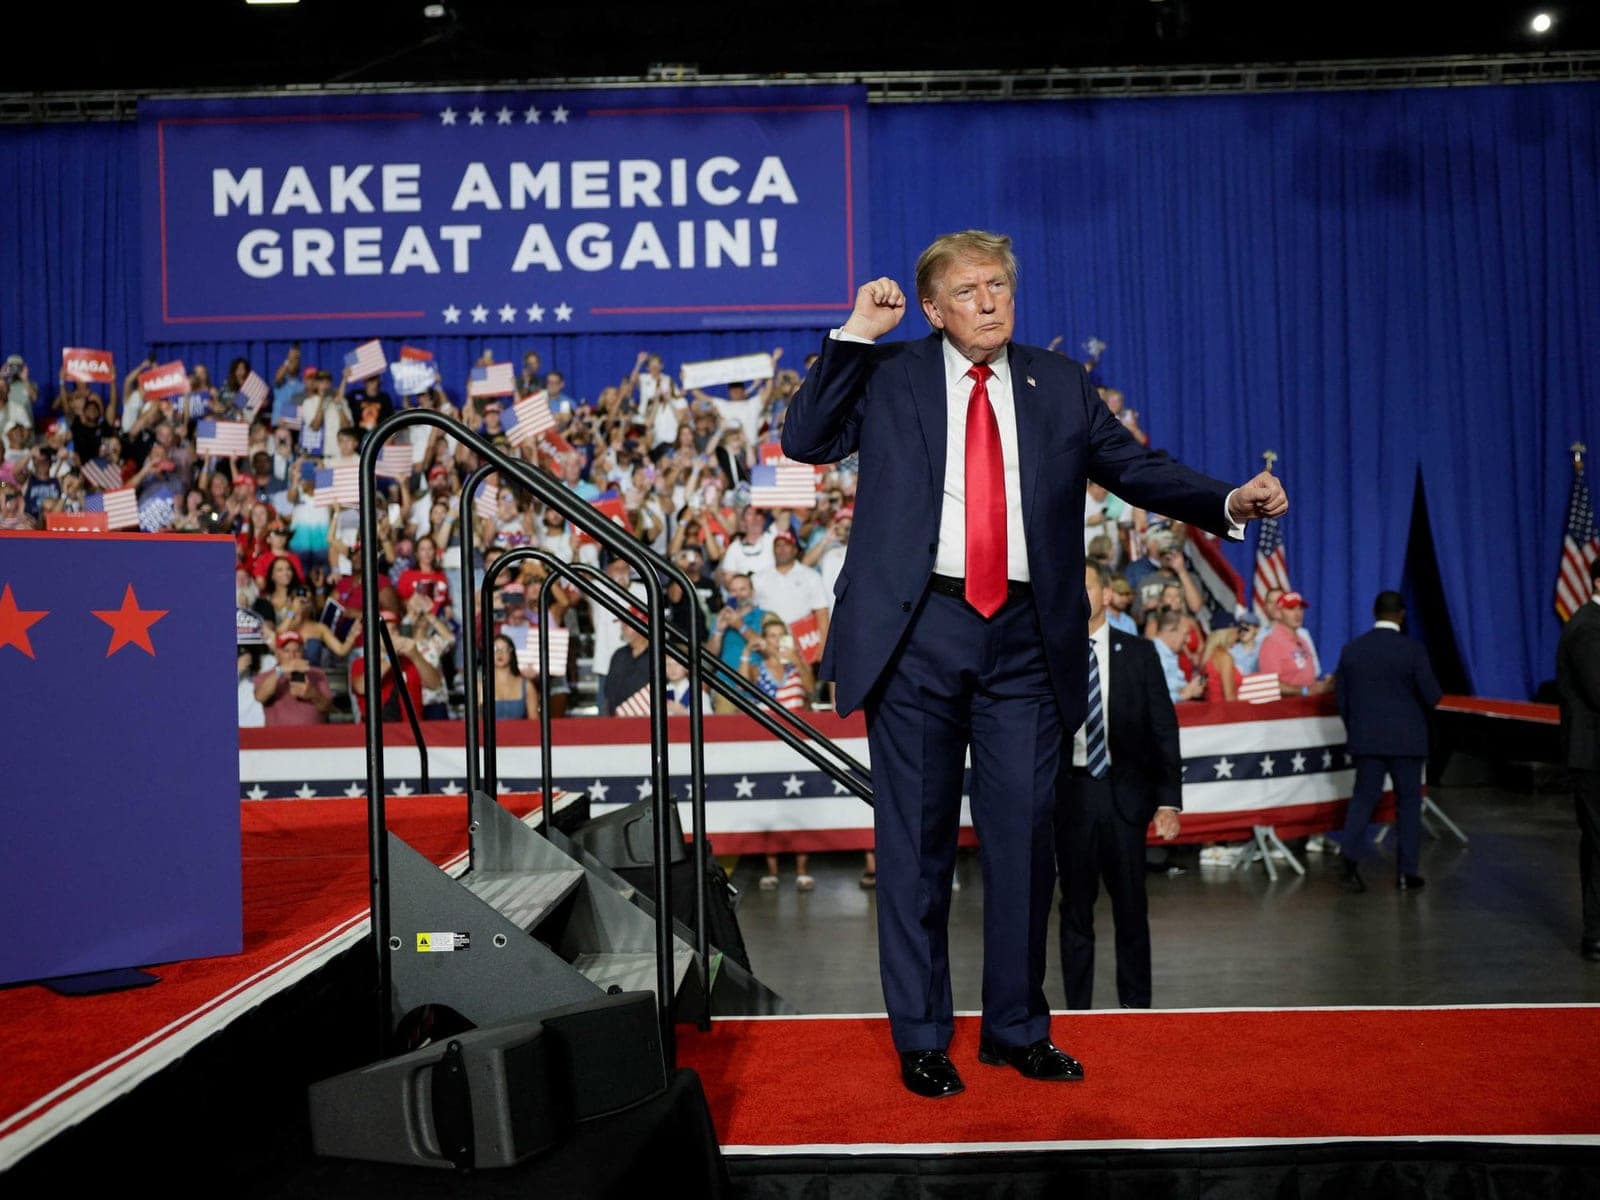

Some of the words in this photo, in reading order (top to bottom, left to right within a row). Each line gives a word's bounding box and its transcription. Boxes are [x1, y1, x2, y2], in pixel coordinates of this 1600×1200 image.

[212, 164, 421, 217] MAKE
[451, 156, 798, 211] AMERICA
[236, 225, 482, 278] GREAT
[511, 218, 777, 272] AGAIN!
